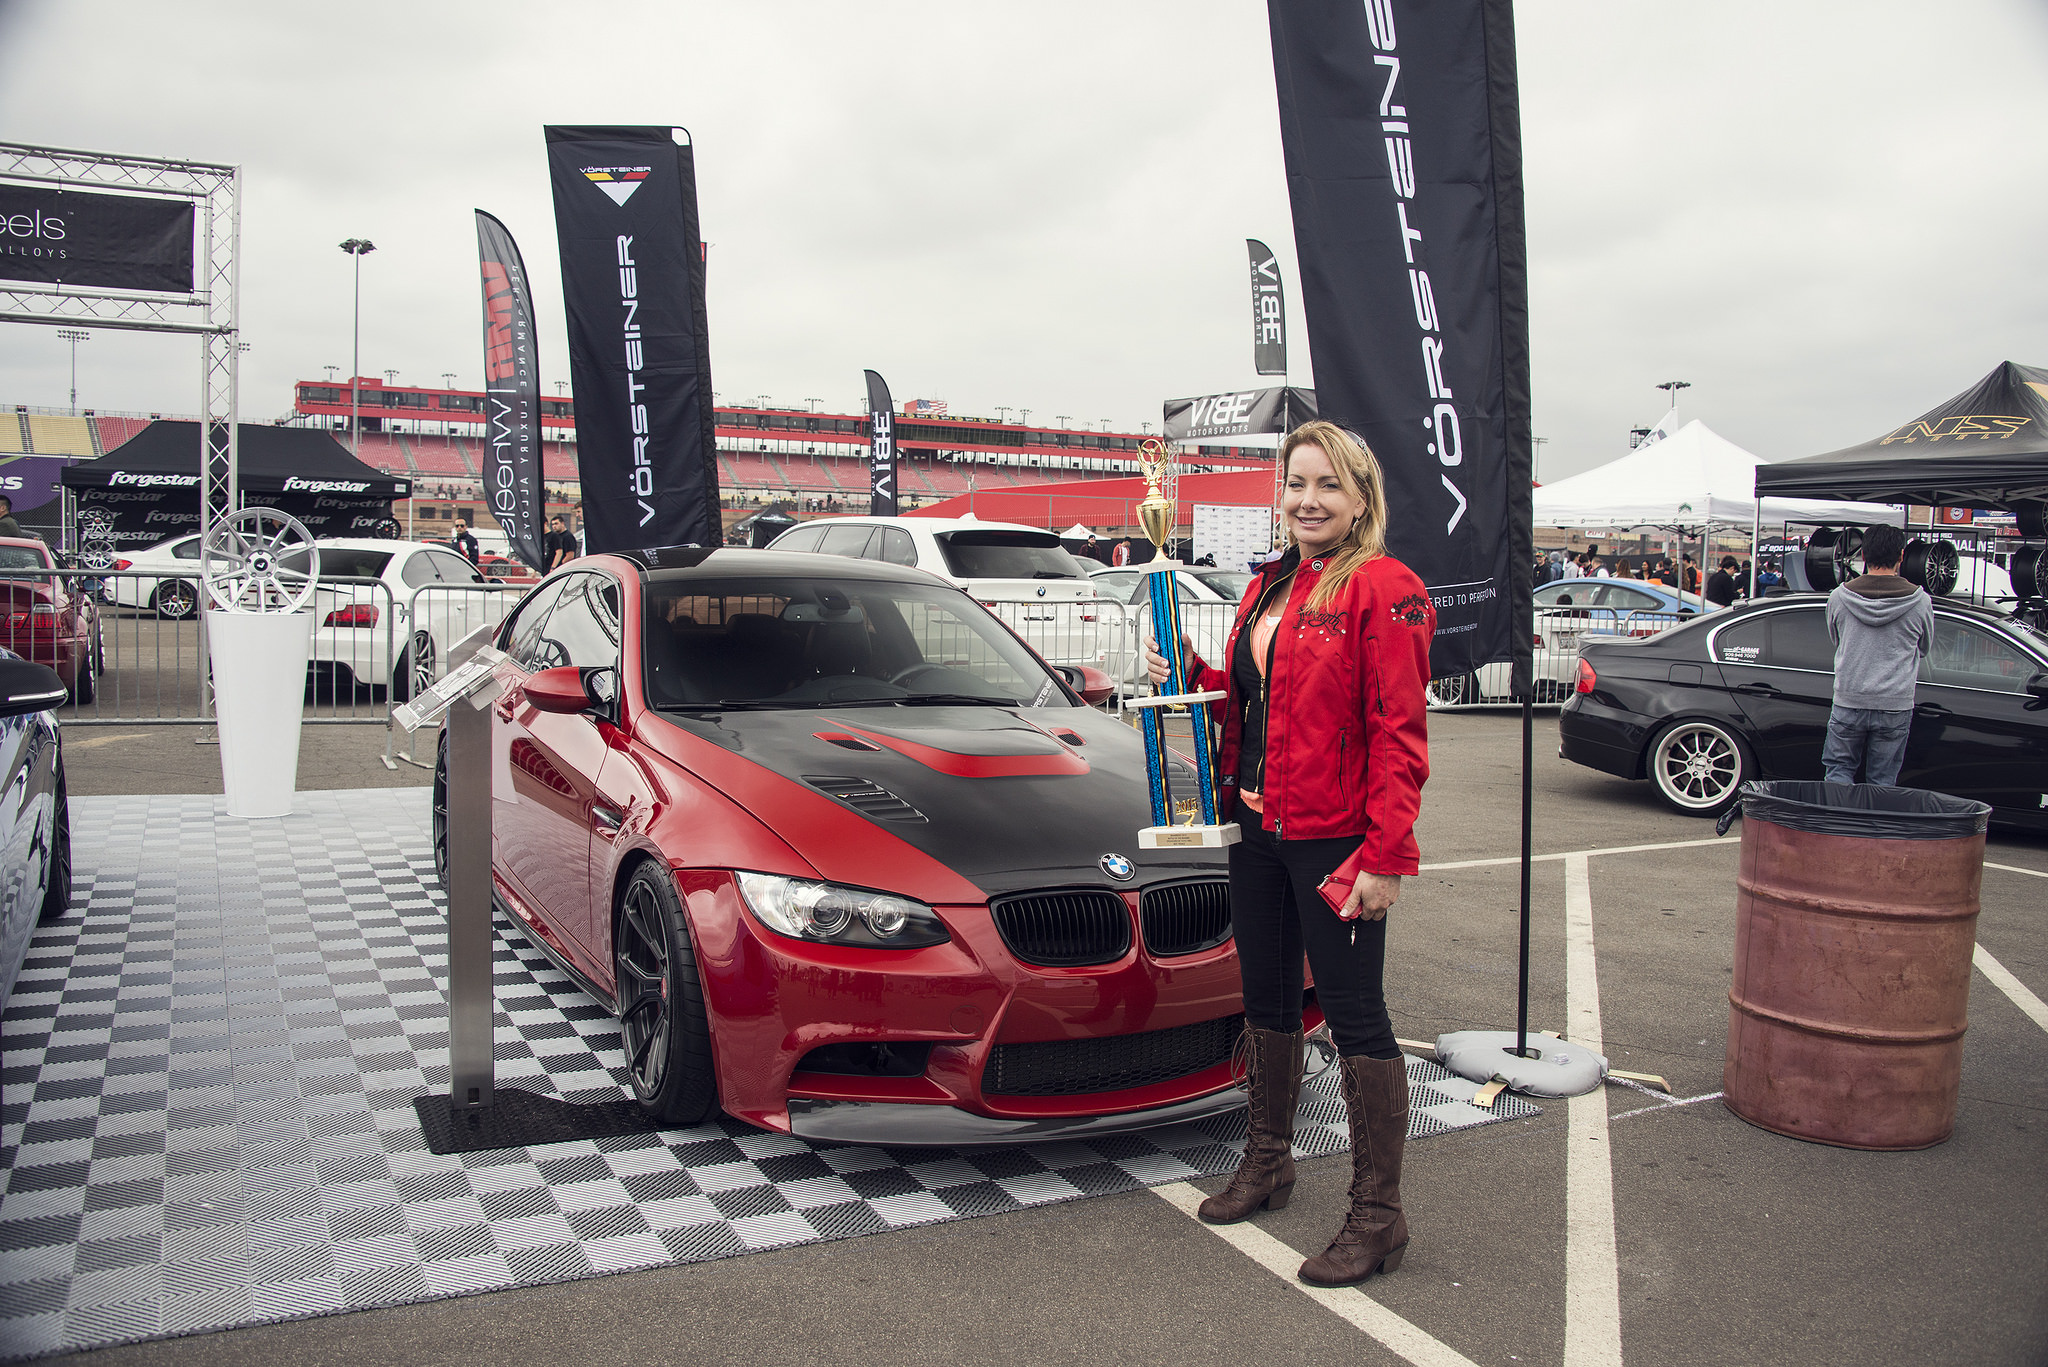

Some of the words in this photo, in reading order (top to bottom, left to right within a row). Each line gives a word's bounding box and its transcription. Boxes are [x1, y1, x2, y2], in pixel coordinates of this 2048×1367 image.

[0, 209, 66, 240] els
[1251, 261, 1262, 345] MOTORSPORTS
[1258, 256, 1282, 345] VIBE
[616, 234, 656, 528] VÖRSTEINER
[1190, 392, 1255, 427] VIBE
[1187, 425, 1249, 438] MOTORSPORTS
[109, 471, 202, 487] forgestar
[283, 477, 371, 493] forgestar
[81, 488, 167, 502] forgestar
[1457, 594, 1466, 605] TO
[1175, 798, 1198, 813] 2015
